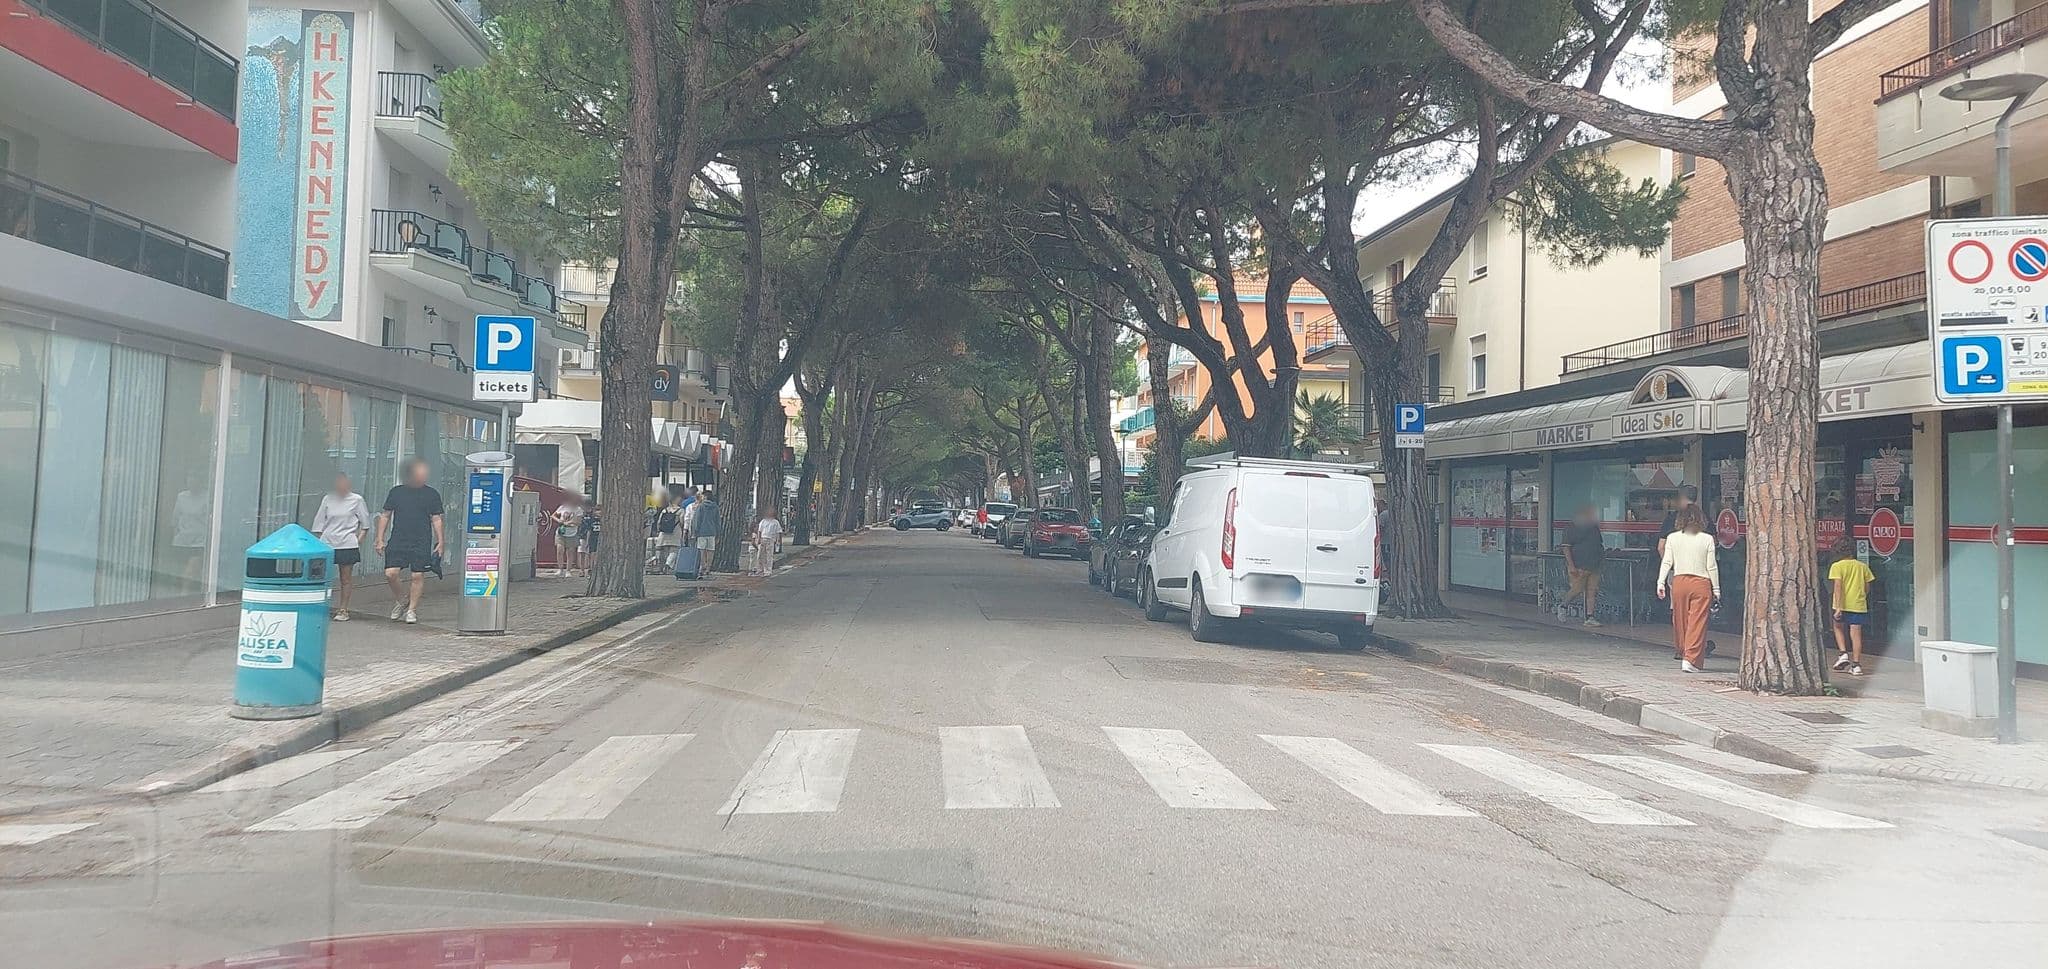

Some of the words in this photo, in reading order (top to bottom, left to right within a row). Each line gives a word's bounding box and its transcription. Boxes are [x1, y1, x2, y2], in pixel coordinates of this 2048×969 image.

[313, 31, 344, 61] H.
[304, 71, 334, 309] KENNEDY
[1974, 229, 2009, 237] traffico
[487, 322, 522, 365] P
[1955, 345, 1990, 386] P
[479, 381, 529, 393] tickets
[1400, 407, 1419, 430] P
[1621, 413, 1649, 434] Ideal
[1653, 410, 1684, 431] Sole
[1536, 423, 1595, 446] MARKET
[1818, 520, 1846, 532] ENTRATA
[239, 636, 289, 650] ALISEA
